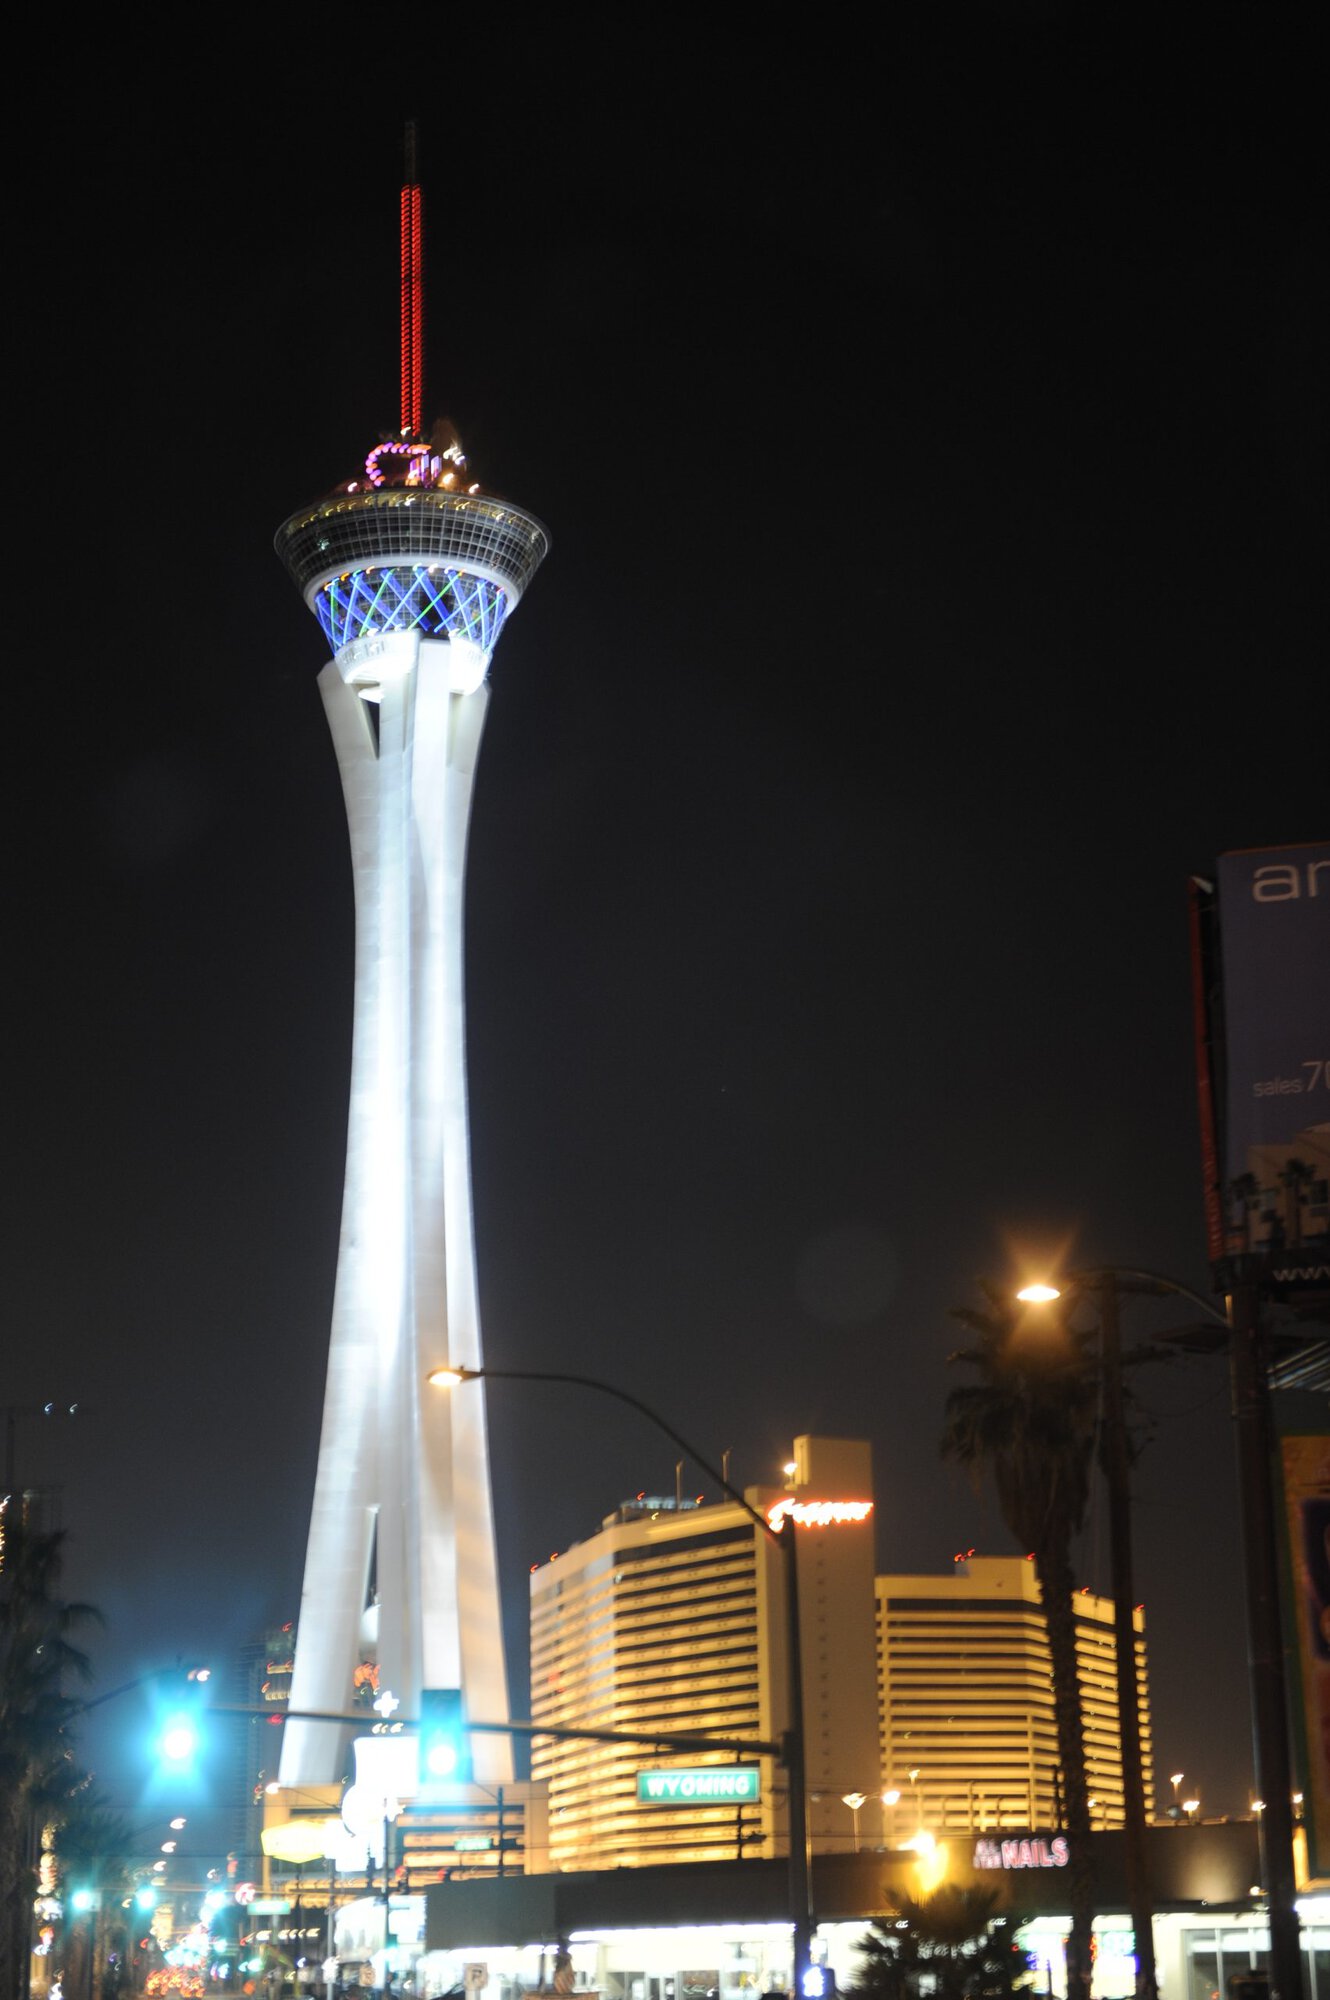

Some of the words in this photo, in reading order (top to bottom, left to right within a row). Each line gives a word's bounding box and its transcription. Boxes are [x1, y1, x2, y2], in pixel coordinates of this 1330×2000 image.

[1253, 1075, 1302, 1097] sales
[646, 1775, 750, 1797] WYOMING
[1001, 1837, 1069, 1869] NAILS
